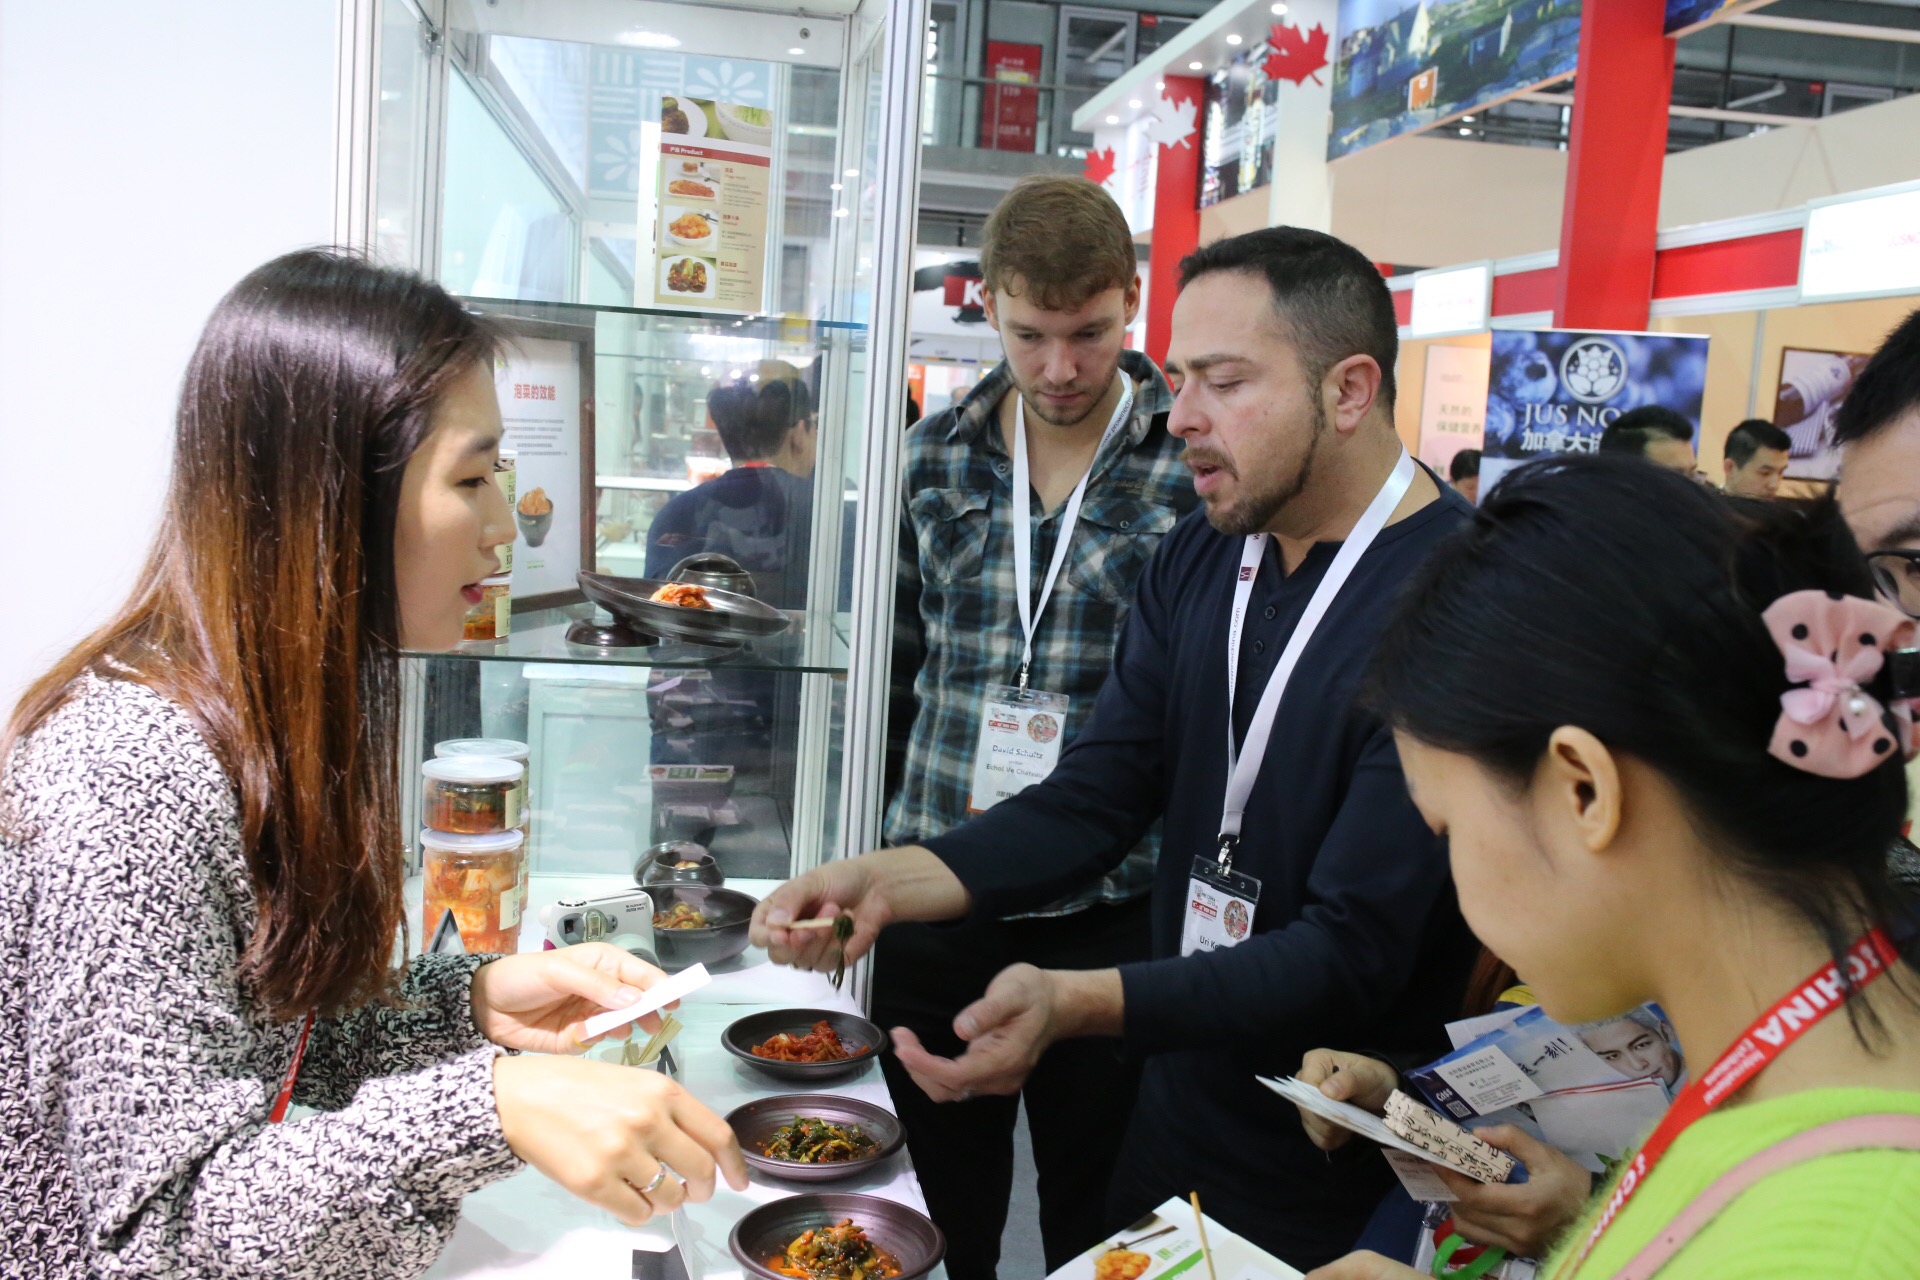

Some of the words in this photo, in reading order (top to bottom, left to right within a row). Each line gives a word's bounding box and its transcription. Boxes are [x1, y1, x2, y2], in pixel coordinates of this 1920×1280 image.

[680, 147, 704, 156] Product
[513, 383, 556, 401] 泡菜的效能
[1522, 402, 1568, 428] JUS
[1576, 405, 1627, 428] NO
[992, 744, 1014, 755] David
[1016, 748, 1043, 759] Schultz
[1006, 765, 1015, 774] Ve
[1017, 768, 1044, 778] Chateau
[1199, 935, 1210, 946] Uri
[1752, 954, 1869, 1047] CHINA
